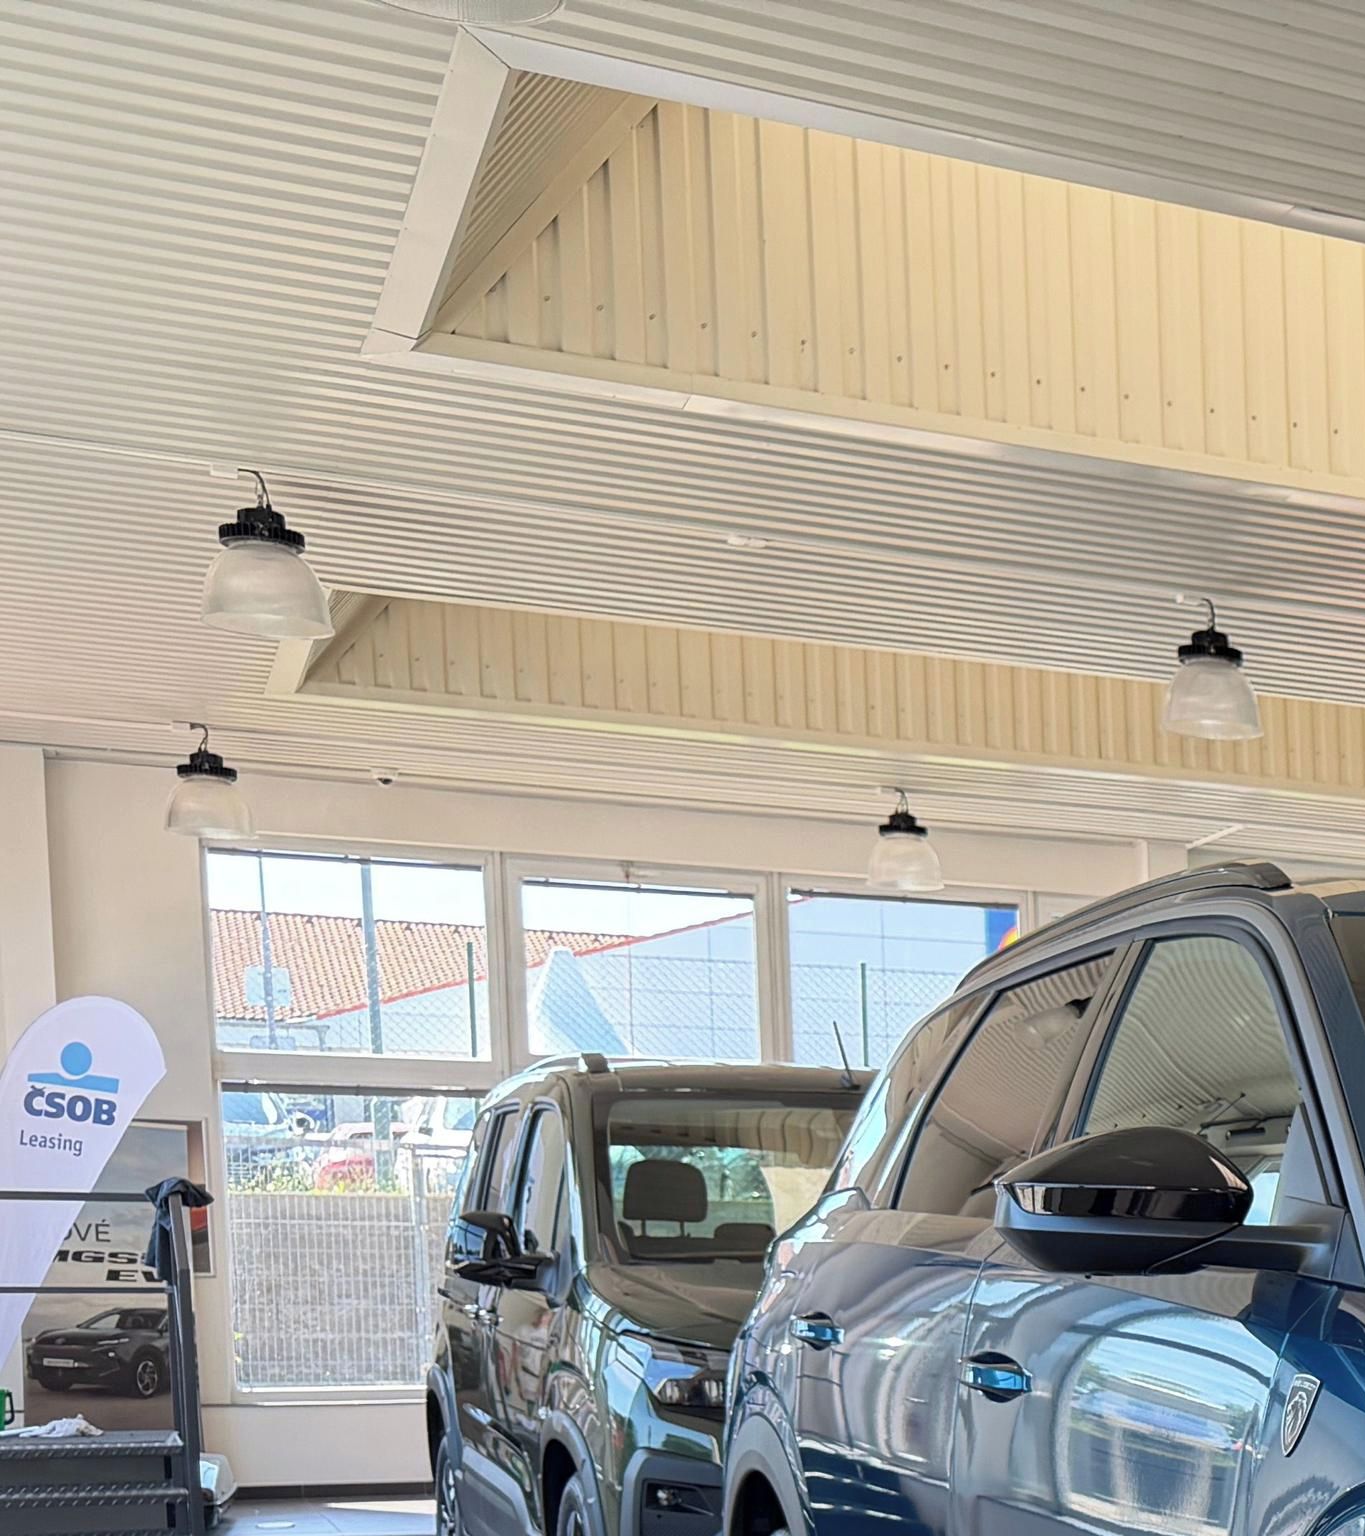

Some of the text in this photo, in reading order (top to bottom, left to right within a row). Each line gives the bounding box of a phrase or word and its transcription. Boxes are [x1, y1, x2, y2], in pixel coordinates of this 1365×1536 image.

[24, 1085, 117, 1126] ČSOB
[19, 1129, 83, 1157] Leasing
[64, 1219, 111, 1242] VÉ
[53, 1250, 146, 1265] GS
